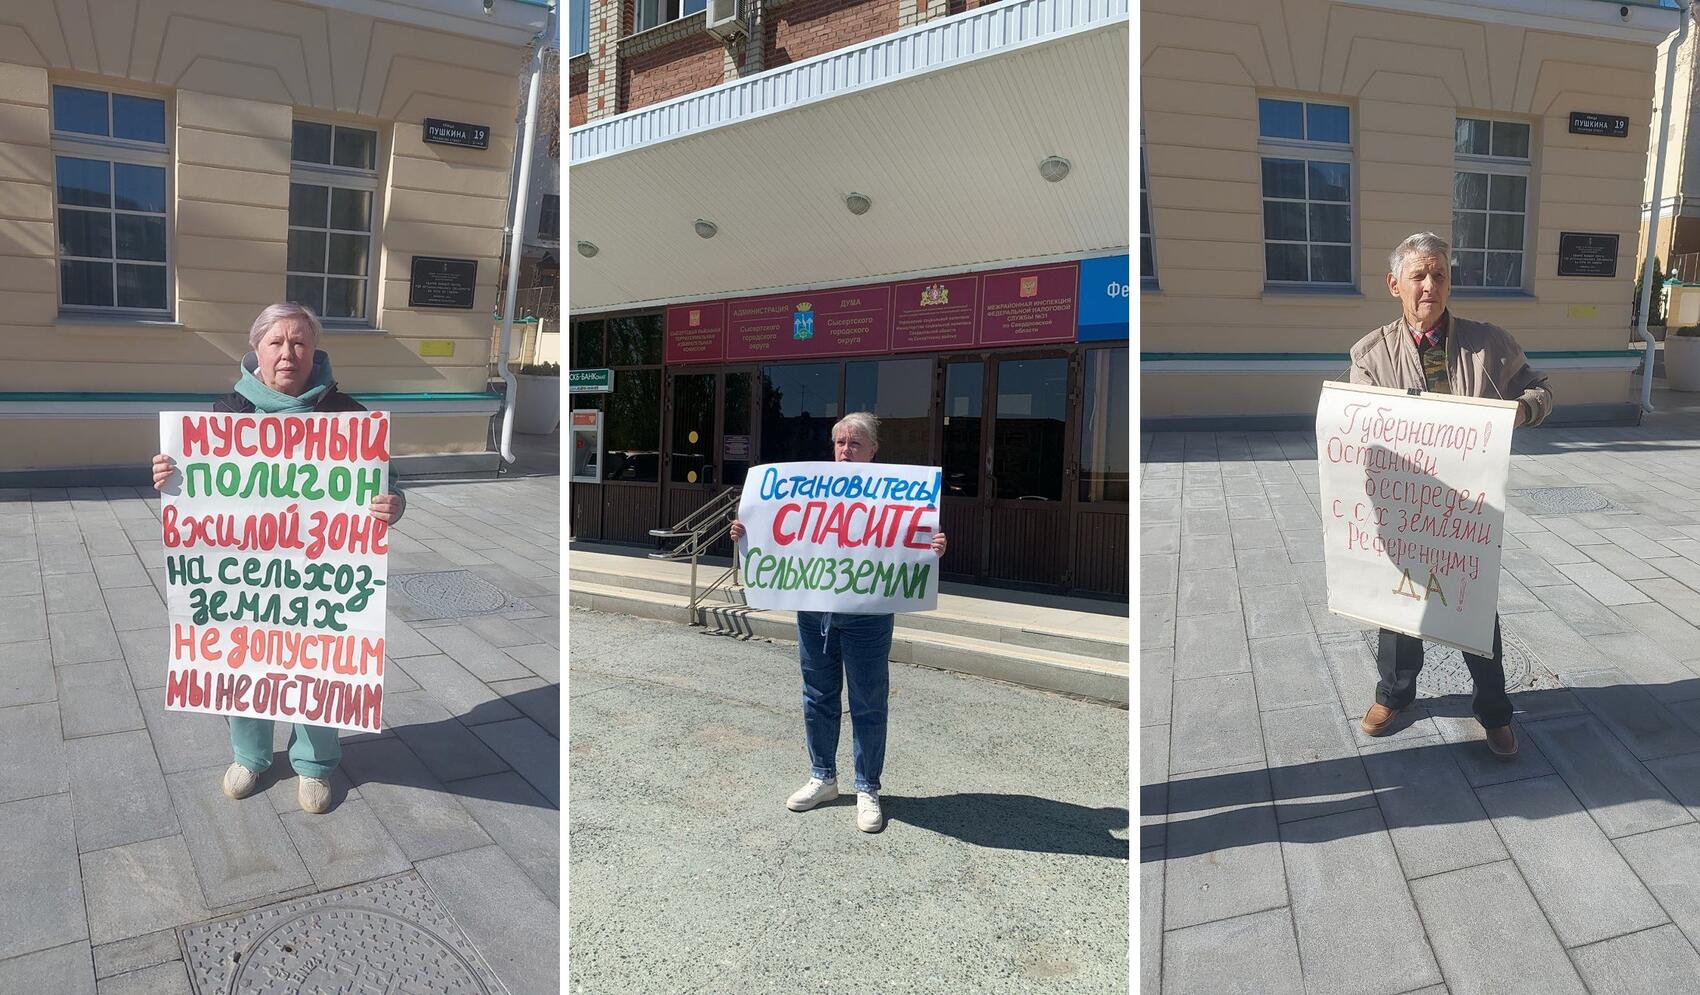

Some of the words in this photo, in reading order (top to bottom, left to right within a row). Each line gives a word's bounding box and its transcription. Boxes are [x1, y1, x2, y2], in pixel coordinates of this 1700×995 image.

[429, 126, 467, 139] ПУШКИНА
[474, 130, 485, 140] 19
[1574, 119, 1609, 129] ПУШКИНА
[1614, 120, 1625, 129] 19
[840, 298, 861, 308] ДУМА
[1107, 281, 1129, 298] Фе
[733, 304, 789, 318] АДМИНИСТРАЦИЯ
[827, 317, 873, 326] Сысертского
[830, 327, 870, 336] городского
[182, 411, 390, 463] МУСОРНЫЙ
[1340, 402, 1493, 461] Губернатор!
[1327, 437, 1439, 476] Останови
[1333, 500, 1344, 518] с
[1364, 468, 1486, 518] беспредел
[181, 504, 305, 551] жилой
[305, 511, 389, 560] зоне
[772, 502, 938, 549] СПАСИТЕ
[1347, 521, 1480, 580] Референдуму
[189, 588, 348, 632] землях
[227, 625, 385, 676] допустим
